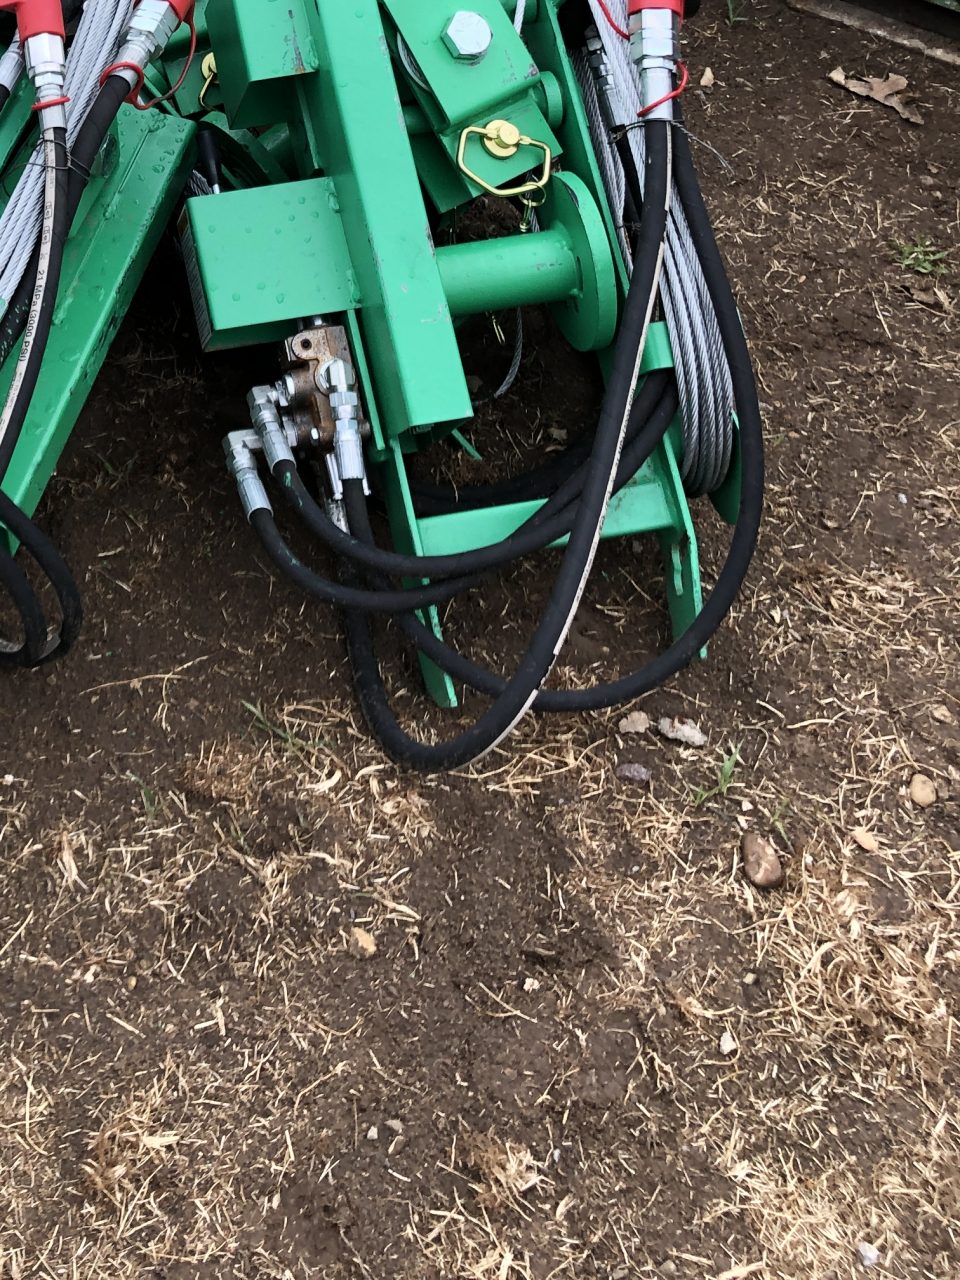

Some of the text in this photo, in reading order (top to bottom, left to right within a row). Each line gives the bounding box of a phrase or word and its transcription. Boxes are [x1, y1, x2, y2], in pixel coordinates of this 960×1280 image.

[37, 269, 45, 281] 21
[31, 284, 43, 308] MPa
[26, 310, 38, 338] (3000
